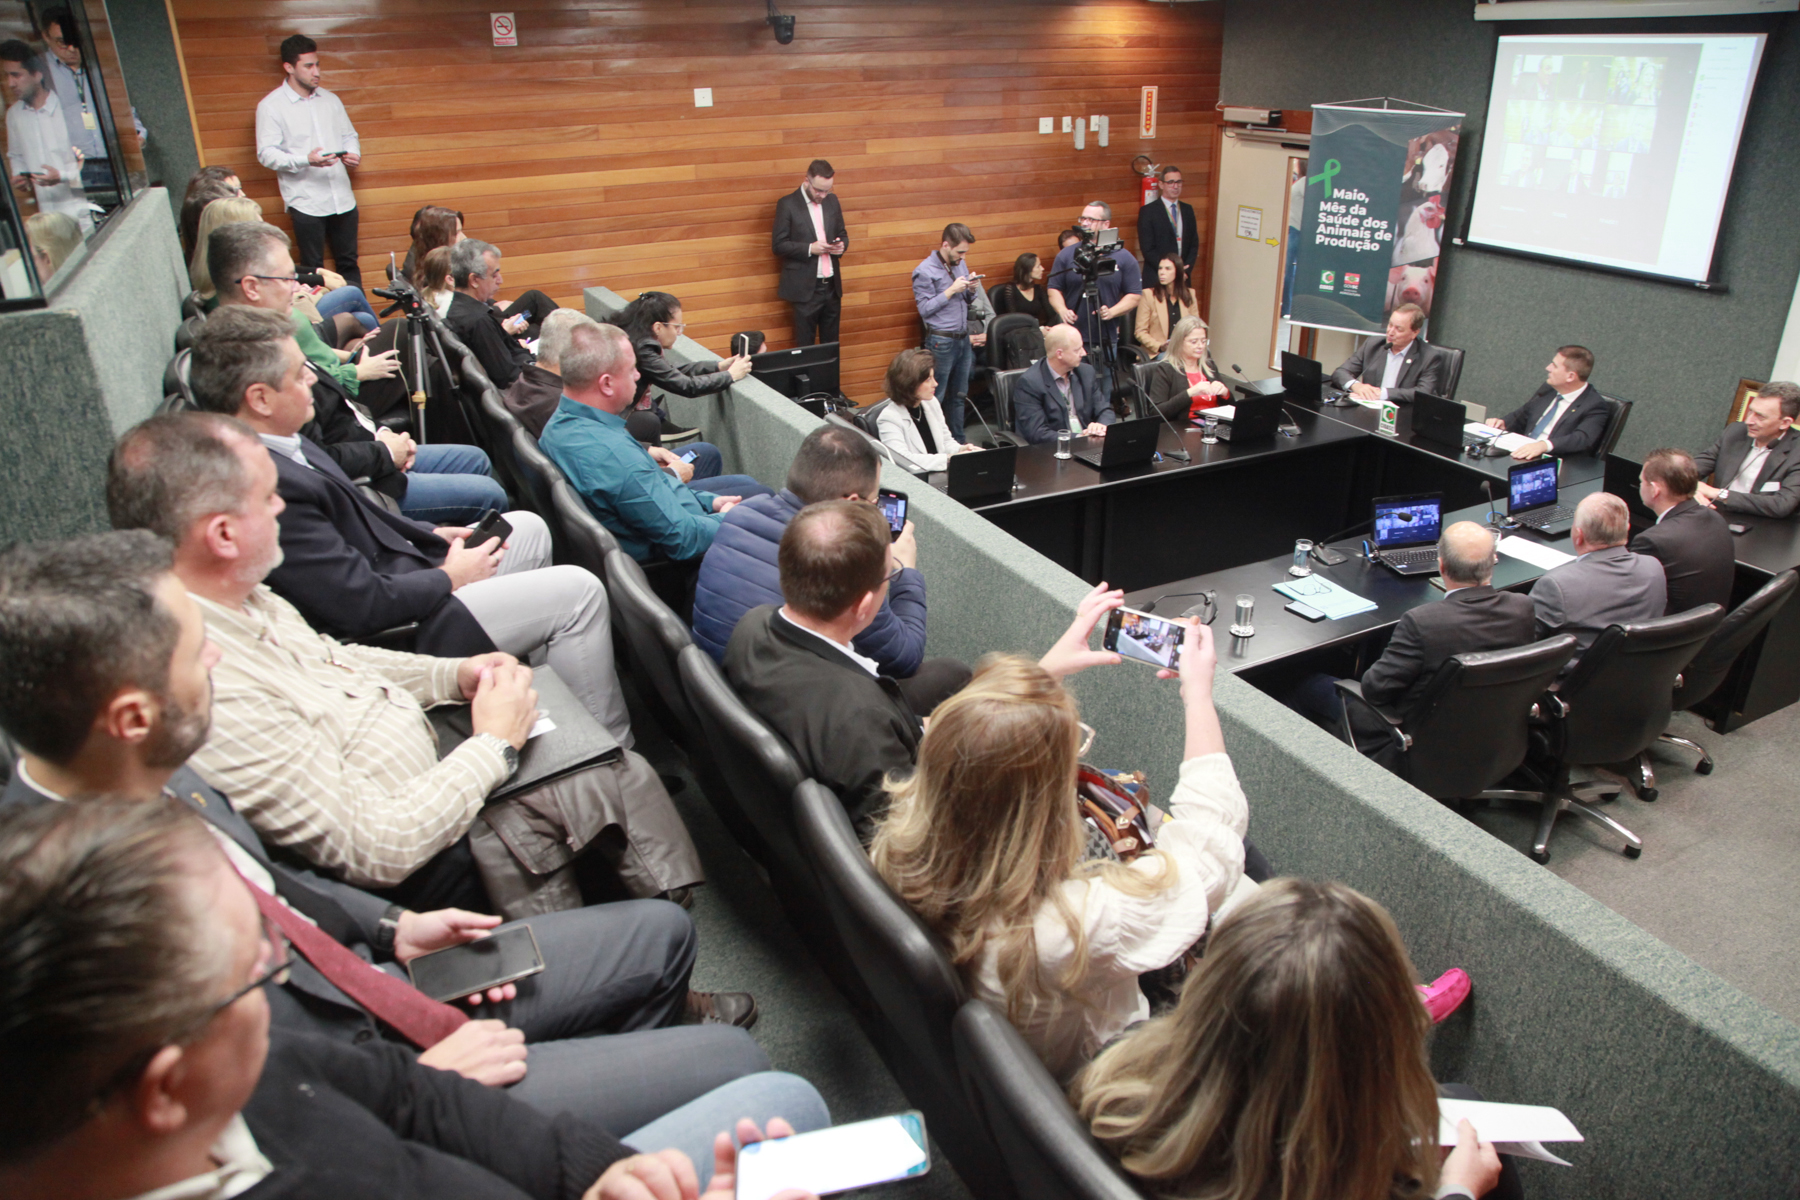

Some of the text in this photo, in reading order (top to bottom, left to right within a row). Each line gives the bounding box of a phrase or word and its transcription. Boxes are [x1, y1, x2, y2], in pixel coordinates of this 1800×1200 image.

[1333, 188, 1370, 203] Maio,
[1320, 201, 1367, 215] Mês da
[1318, 212, 1388, 229] Saúde dos
[1316, 223, 1393, 241] Animais de
[1315, 234, 1380, 252] Produção
